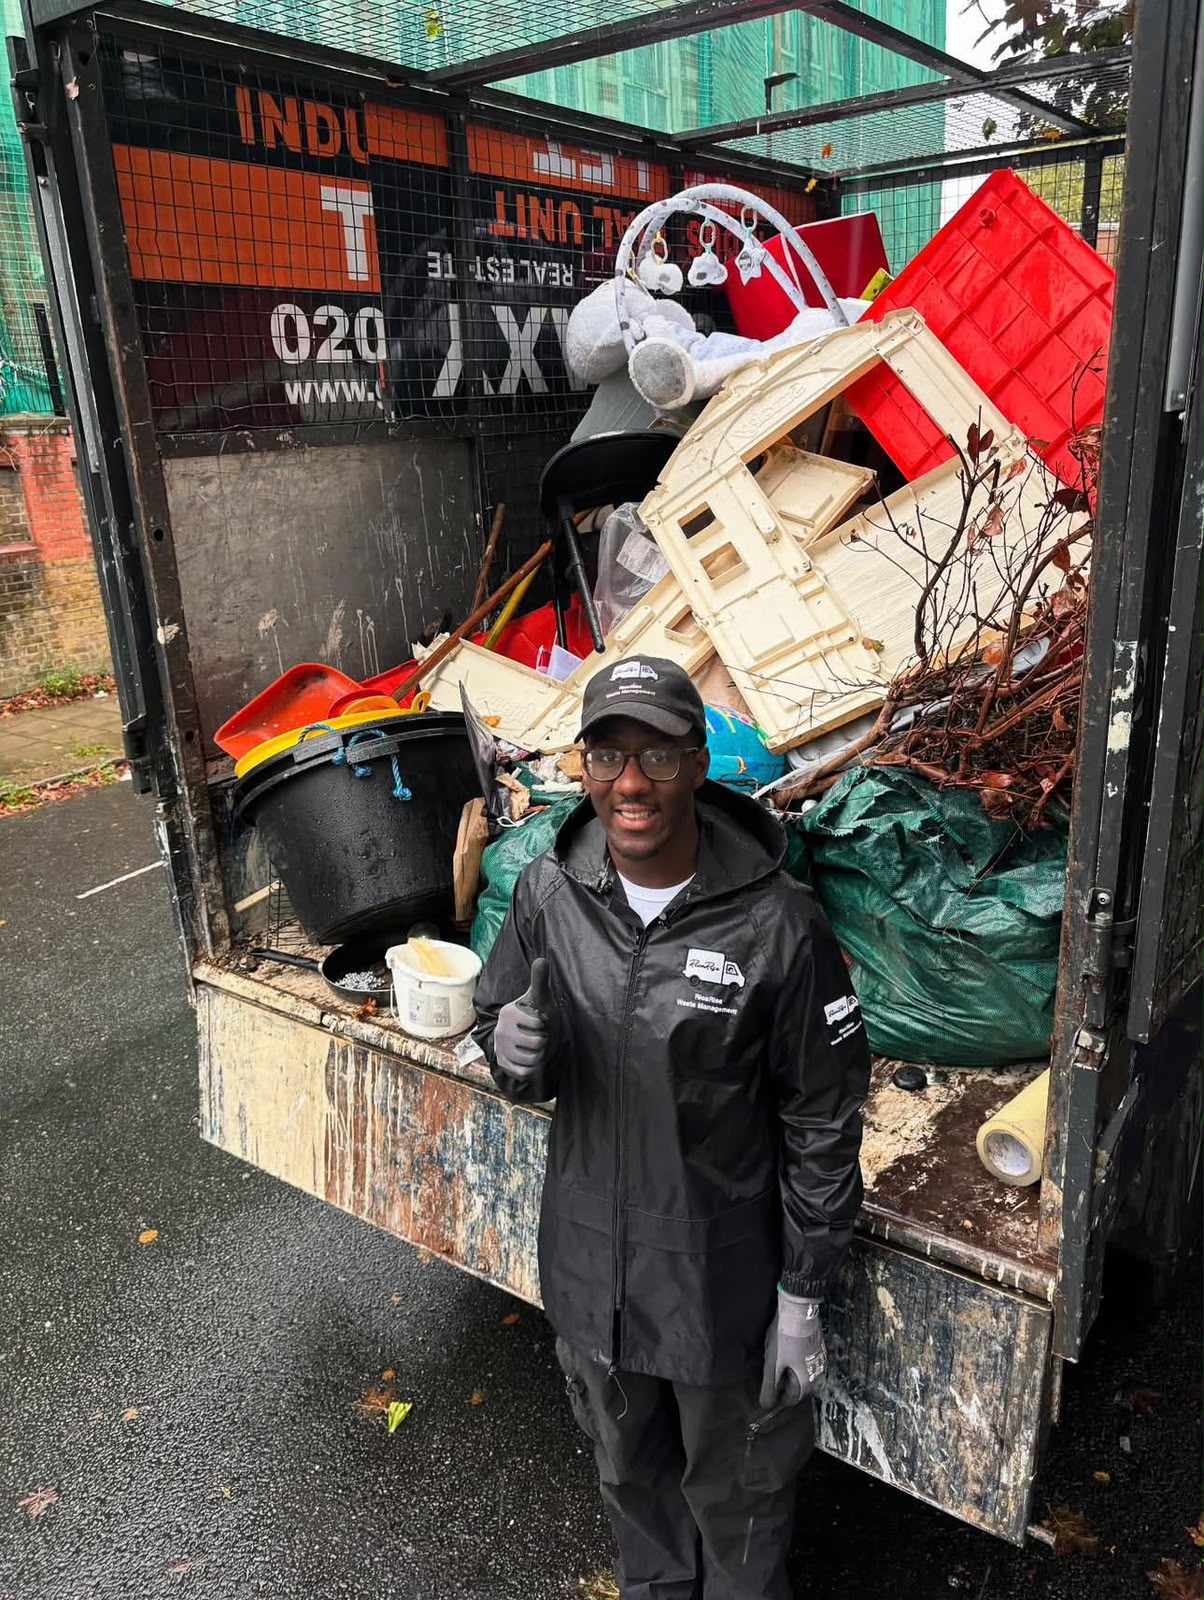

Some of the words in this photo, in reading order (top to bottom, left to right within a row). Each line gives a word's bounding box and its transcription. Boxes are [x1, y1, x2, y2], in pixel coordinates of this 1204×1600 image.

[488, 190, 583, 245] UNIT
[427, 251, 515, 283] ESTTE
[270, 303, 387, 364] 020
